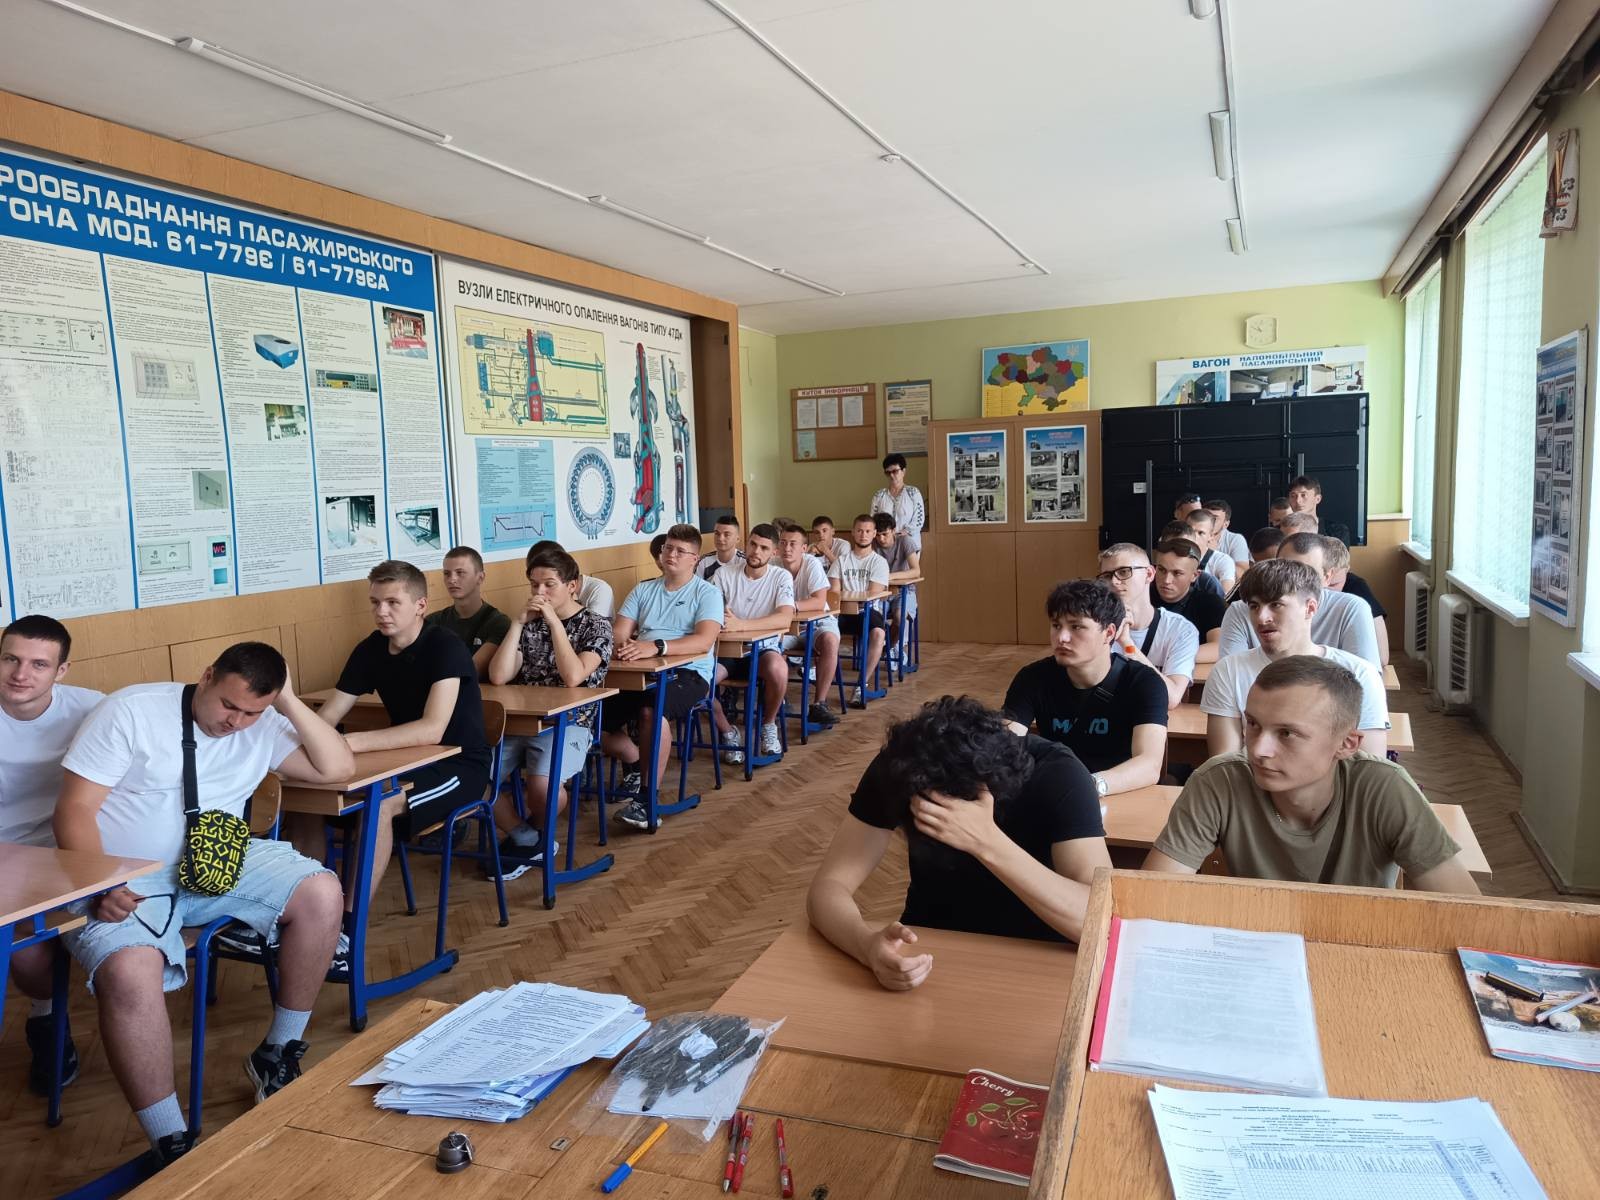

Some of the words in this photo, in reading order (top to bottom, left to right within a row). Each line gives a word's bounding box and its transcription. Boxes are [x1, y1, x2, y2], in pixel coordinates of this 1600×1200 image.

[87, 213, 158, 249] МОД.
[239, 220, 414, 276] ПАСАЖИРСЬКОГО
[458, 279, 493, 301] ВУЗЛИ
[496, 288, 572, 316] ЕЛЕКТРИЧНОГО
[574, 305, 619, 326] ОПАЛЕННЯ
[619, 315, 649, 333] ВАГОНІВ
[650, 322, 667, 337] ТИПУ
[1192, 358, 1231, 369] ВАГОН
[970, 1075, 1015, 1097] Cherry
